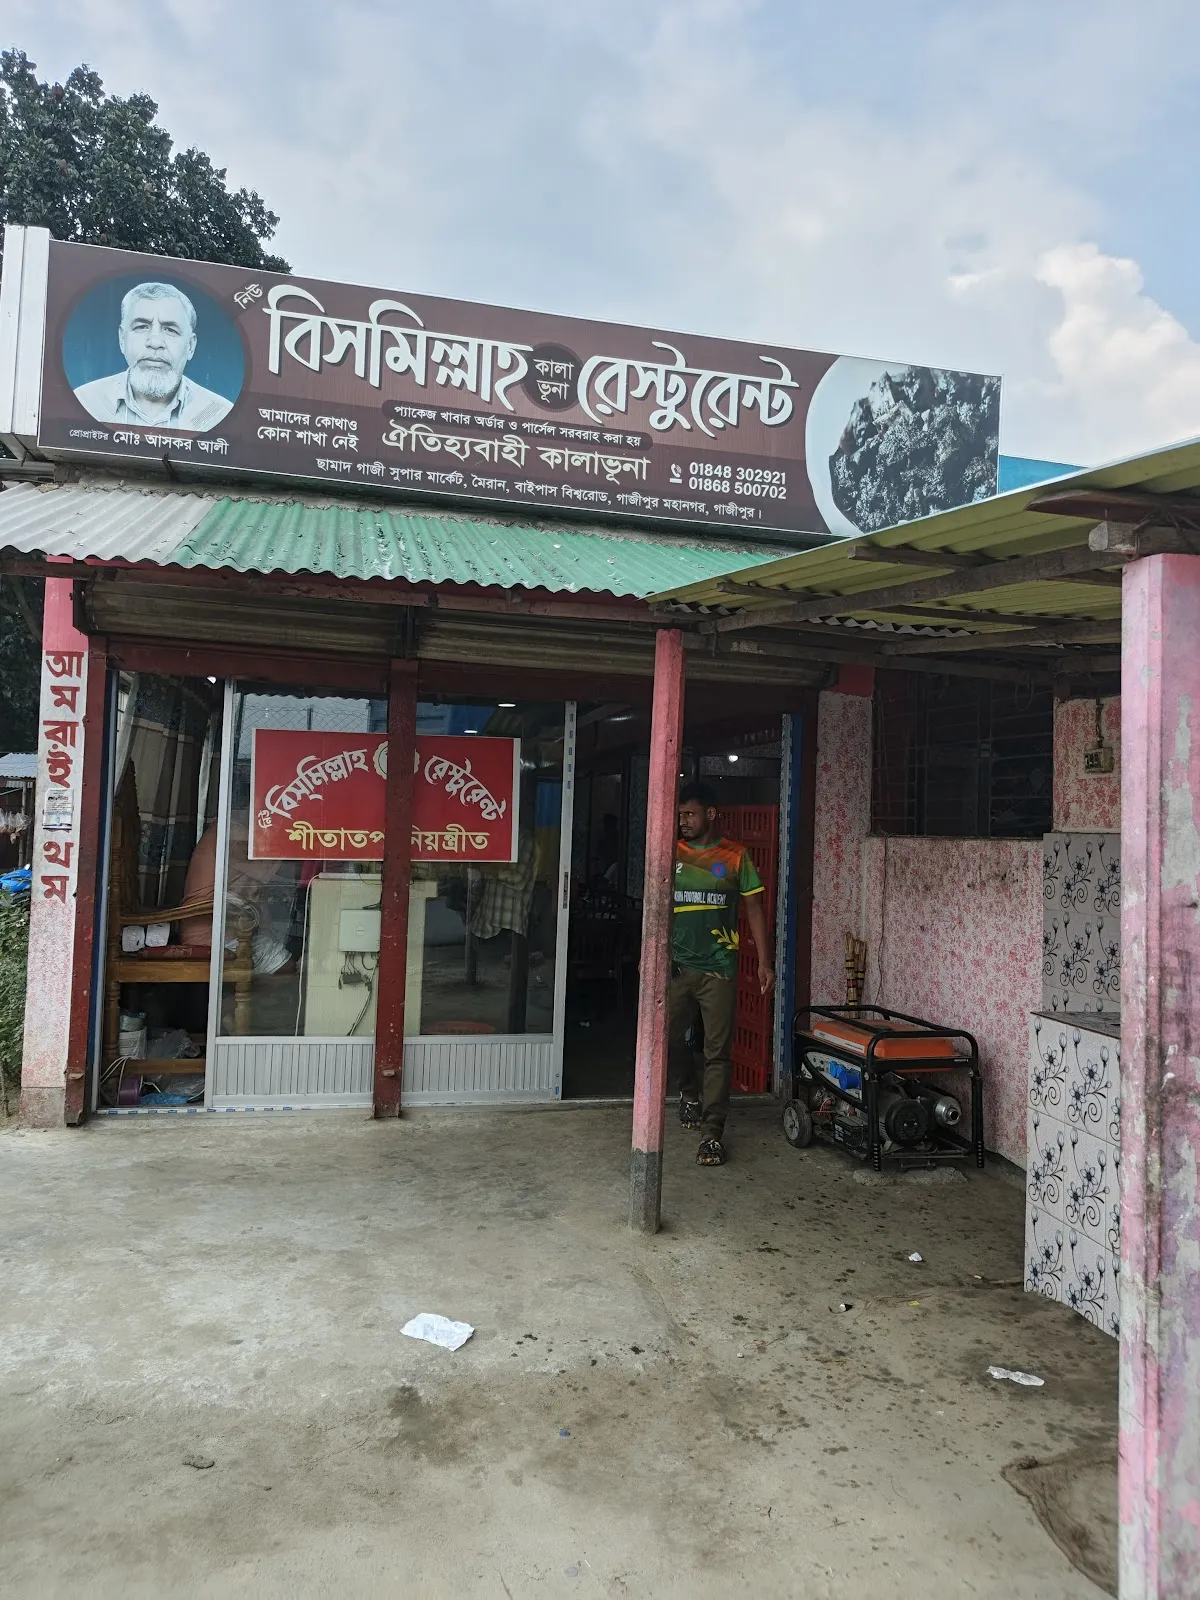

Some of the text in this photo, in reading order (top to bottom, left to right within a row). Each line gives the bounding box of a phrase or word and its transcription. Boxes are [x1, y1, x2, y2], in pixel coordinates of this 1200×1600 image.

[233, 283, 264, 310] নিউ
[263, 284, 799, 438] বিসমিল্লাহ রেস্টুরেন্ট
[533, 358, 575, 381] কালা
[536, 379, 570, 403] ভূনা
[258, 408, 358, 431] আমাদের কোথাও
[394, 405, 641, 447] প্যাকেজ খাবার অর্ডার ও পার্সেল সরবরাহ করা হয়
[113, 430, 141, 446] মোঃ
[144, 433, 193, 451] আসকর
[197, 437, 230, 456] আলী
[257, 426, 360, 452] কোন শাখা নেই
[381, 418, 652, 485] ঐতিহ্যবাহী কালাভূনা
[689, 461, 786, 485] 01848 302921
[315, 457, 353, 473] ছামাদ
[356, 461, 387, 477] গাজী
[389, 466, 423, 482] সুপার
[426, 469, 468, 489] মার্কেট,
[471, 473, 510, 494] মৈরান,
[514, 479, 558, 497] বাইপাস
[561, 484, 612, 506] বিশ্বরোড,
[616, 490, 659, 510] গাজীপুর
[662, 499, 709, 516] মহানগর,
[688, 476, 787, 500] 01868 500702
[257, 810, 273, 829] নিউ
[424, 755, 506, 821] রেস্টুরেন্ট
